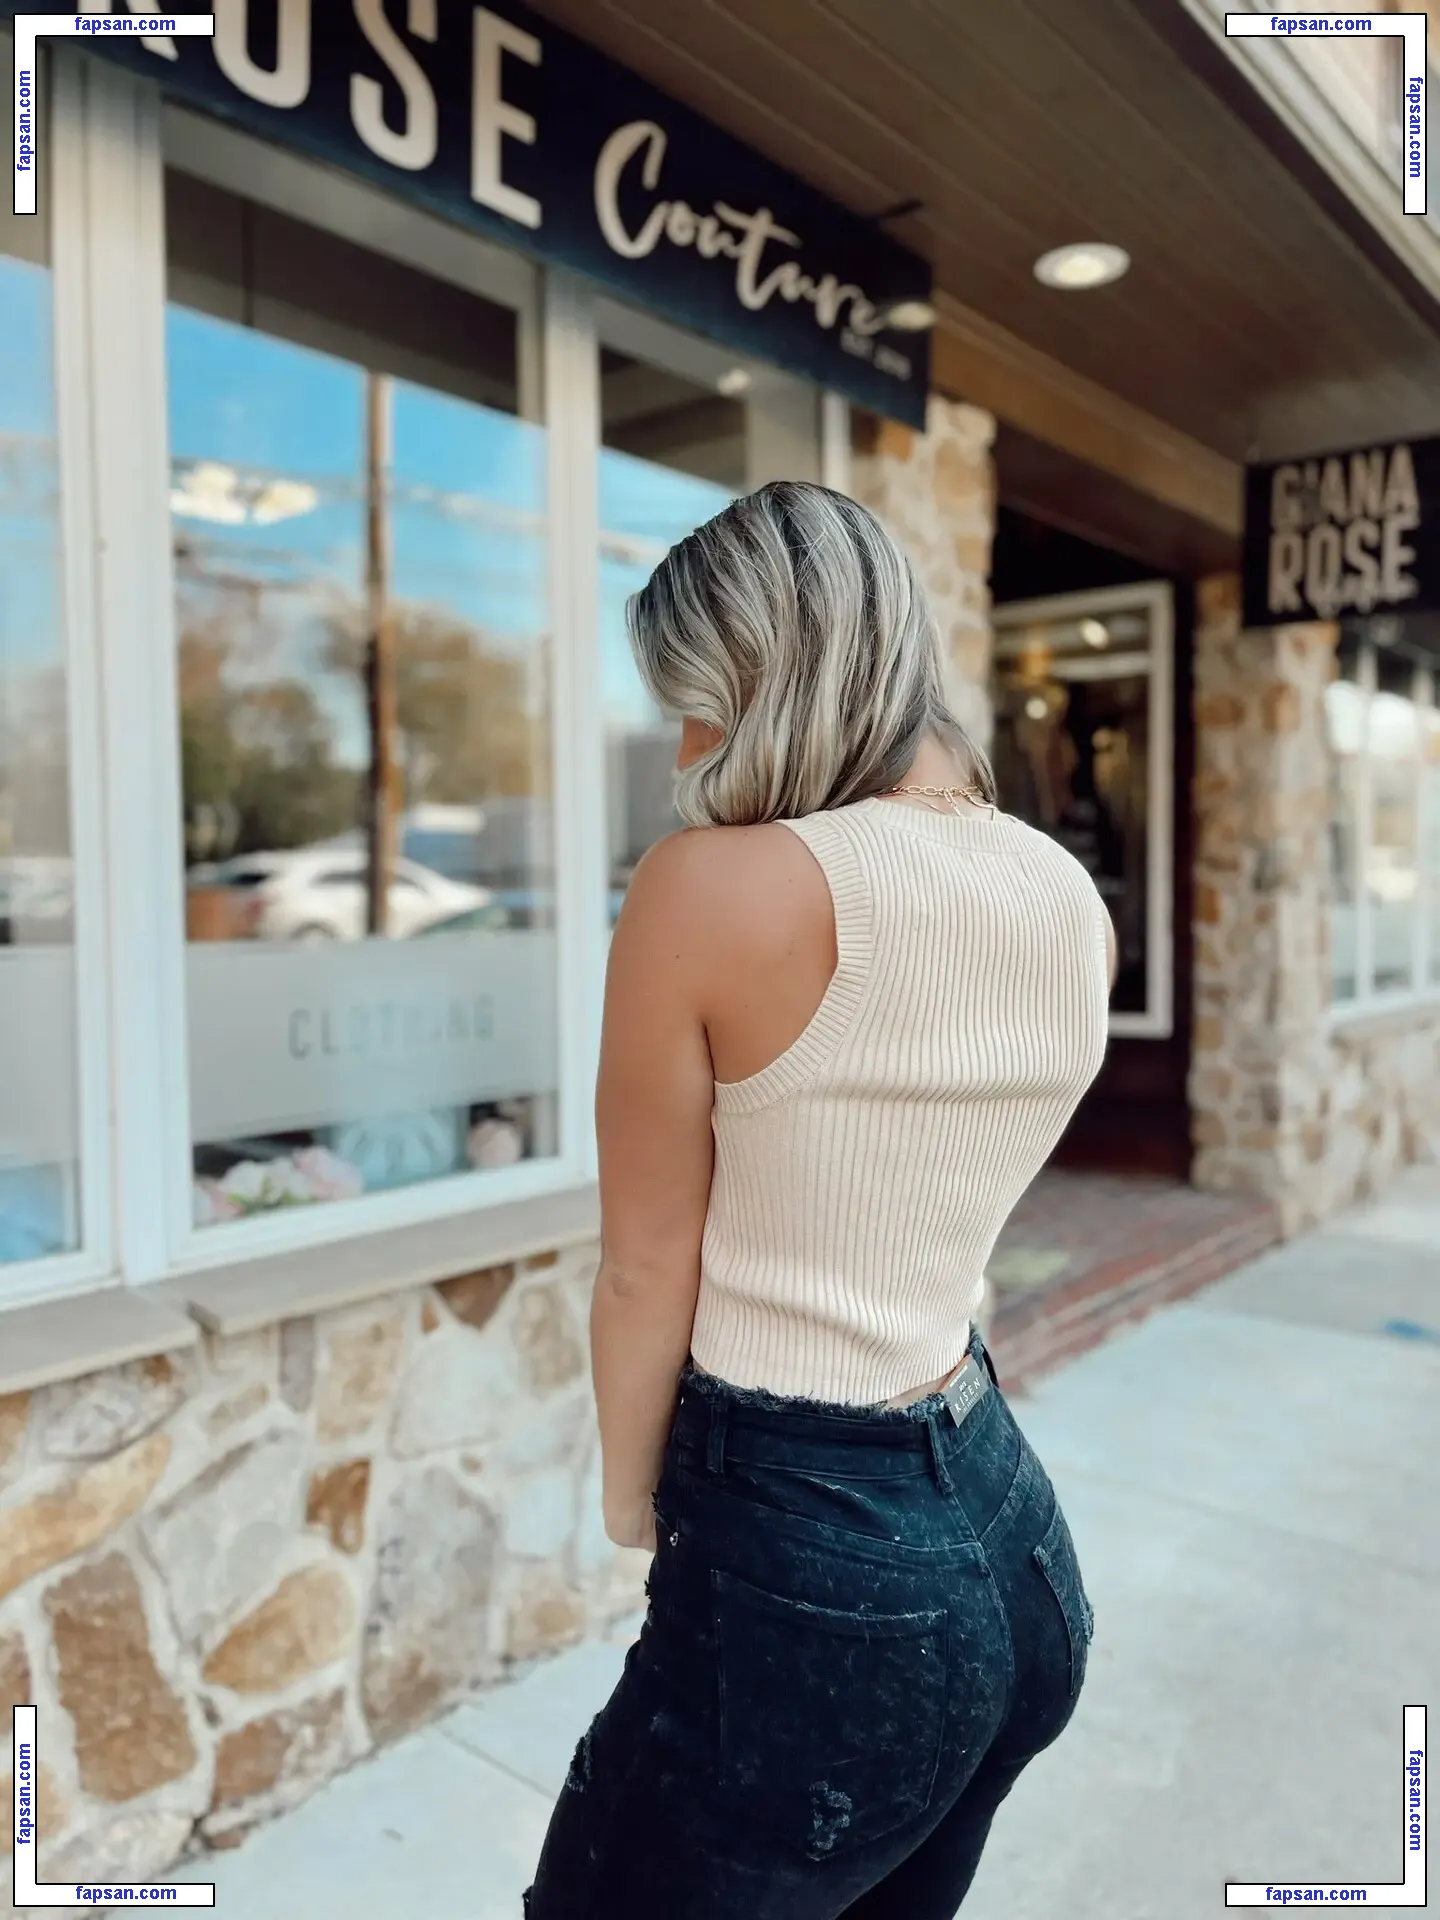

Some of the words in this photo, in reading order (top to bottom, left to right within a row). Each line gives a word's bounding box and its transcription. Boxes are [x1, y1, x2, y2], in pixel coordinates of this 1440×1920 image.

[76, 0, 542, 229] OSE
[594, 121, 888, 335] Couture
[1267, 517, 1420, 614] ROSE
[954, 1377, 981, 1413] RISEN
